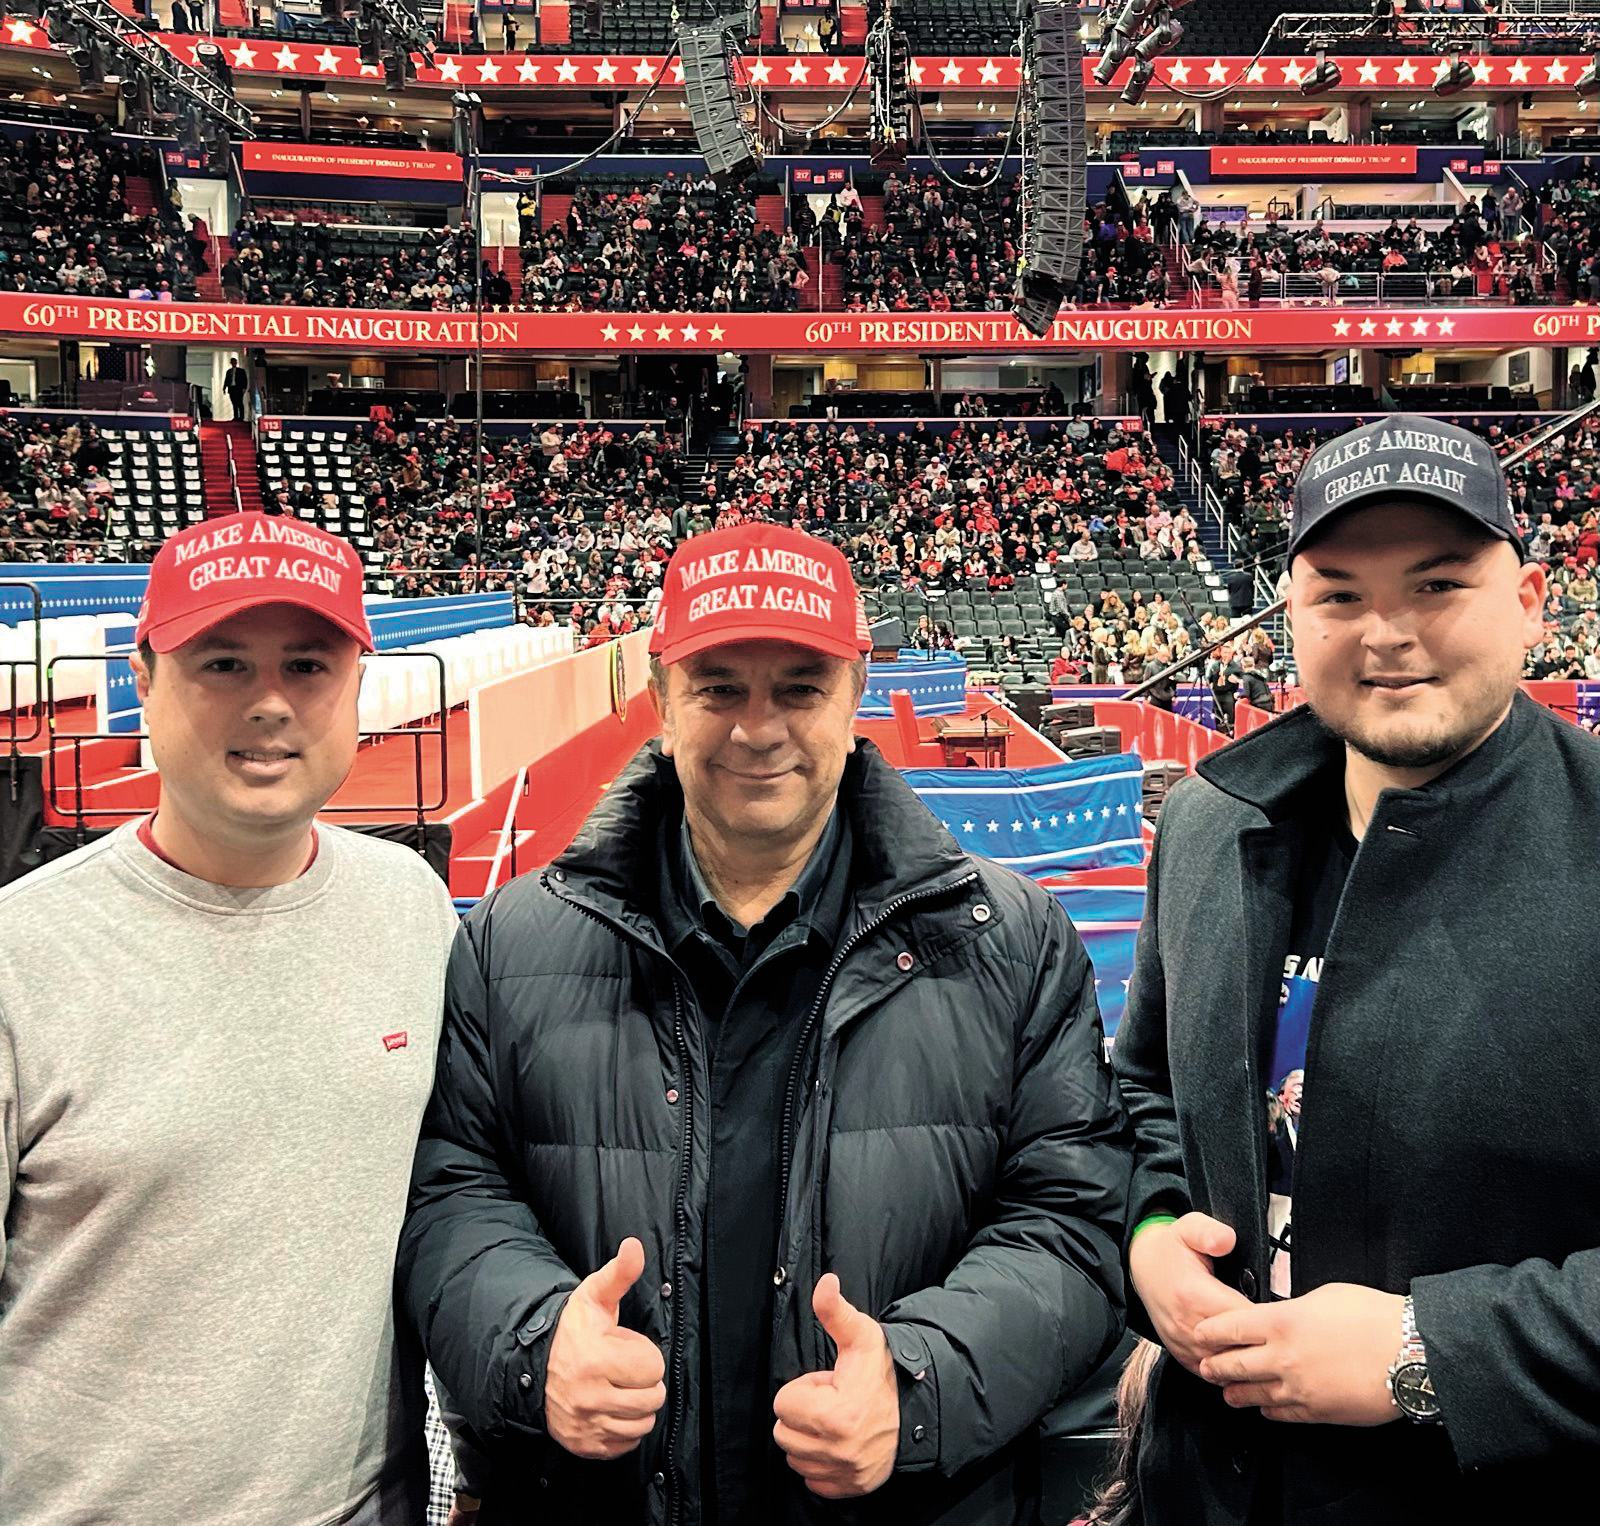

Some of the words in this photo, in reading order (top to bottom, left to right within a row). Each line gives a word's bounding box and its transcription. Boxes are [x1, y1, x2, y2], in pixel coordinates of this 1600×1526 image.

[337, 157, 374, 166] PRESIDENT
[376, 159, 405, 167] DONALD
[412, 161, 436, 169] TRUMP
[23, 303, 79, 327] 60TH
[87, 306, 300, 338] PRESIDENTIAL
[306, 316, 519, 343] INAUGURATION
[805, 321, 852, 343] 60TH
[1052, 318, 1253, 341] INAUGURATION
[1533, 313, 1580, 336] 60TH
[175, 421, 190, 429] 114
[263, 421, 279, 430] 113
[1126, 422, 1139, 431] 112
[1312, 436, 1371, 480] MAKE
[1376, 430, 1478, 466] AMERICA
[1324, 463, 1390, 504] GREAT
[1396, 462, 1467, 496] AGAIN
[173, 523, 243, 567] MAKE
[248, 520, 350, 569] AMERICA
[188, 556, 271, 592] GREAT
[275, 557, 342, 595] AGAIN
[679, 549, 740, 591] MAKE
[742, 548, 837, 593] AMERICA
[688, 584, 759, 622] GREAT
[760, 585, 832, 622] AGAIN
